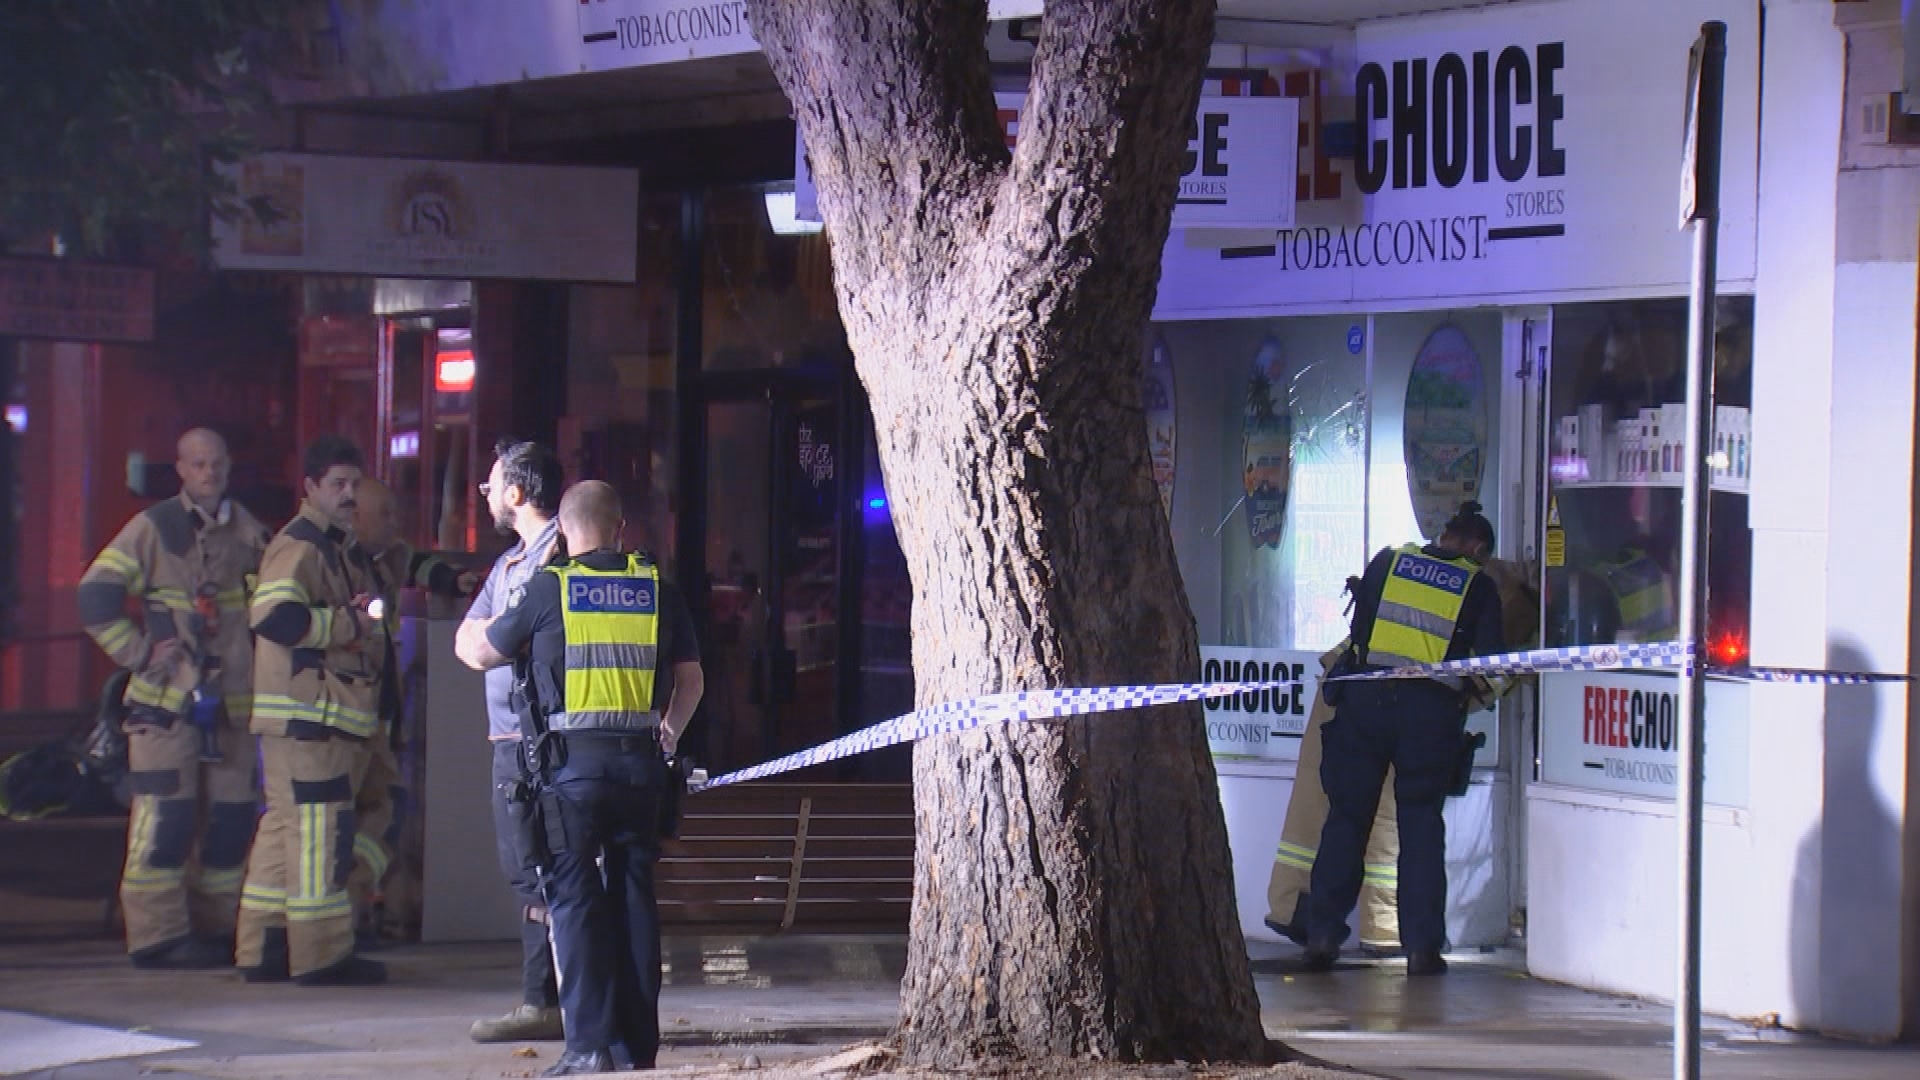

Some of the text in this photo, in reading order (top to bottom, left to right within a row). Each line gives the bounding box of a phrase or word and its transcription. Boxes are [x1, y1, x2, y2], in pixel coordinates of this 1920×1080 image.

[615, 1, 742, 49] TOBACCONIST
[1180, 181, 1227, 194] TORES
[1505, 189, 1565, 217] STORES
[1397, 557, 1463, 589] Police
[570, 582, 651, 608] Police
[1208, 721, 1271, 744] CCONIST
